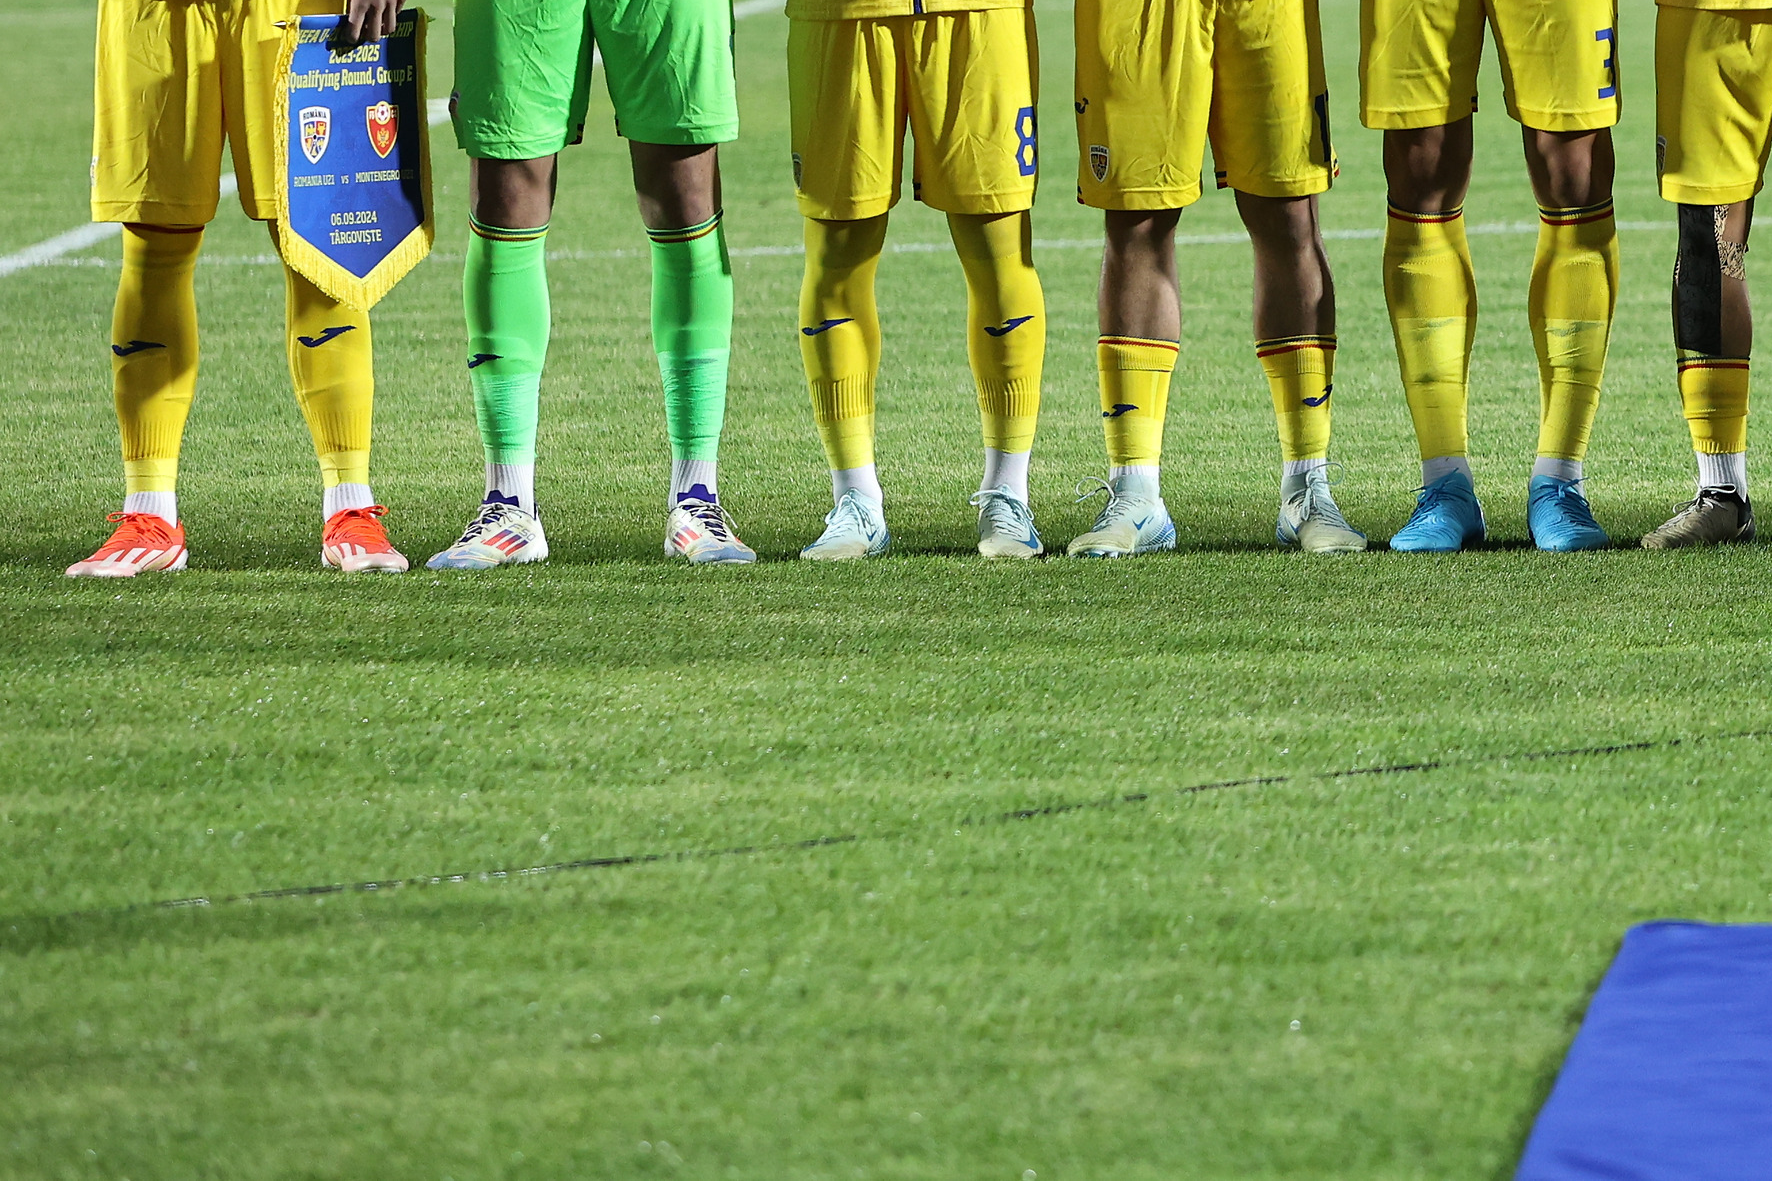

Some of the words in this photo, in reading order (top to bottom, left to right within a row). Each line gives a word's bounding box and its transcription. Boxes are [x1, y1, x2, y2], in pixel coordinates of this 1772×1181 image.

[330, 45, 380, 63] 2023-2025
[290, 69, 340, 93] Qualifying
[342, 67, 375, 86] Round,
[376, 66, 405, 86] Group
[407, 65, 413, 81] E
[1015, 106, 1036, 177] 8
[294, 175, 322, 187] ROMANIA
[356, 170, 400, 183] MONTENEGRO
[330, 211, 378, 225] 06.09.2024
[330, 229, 382, 245] TÂRGOVIȘTE
